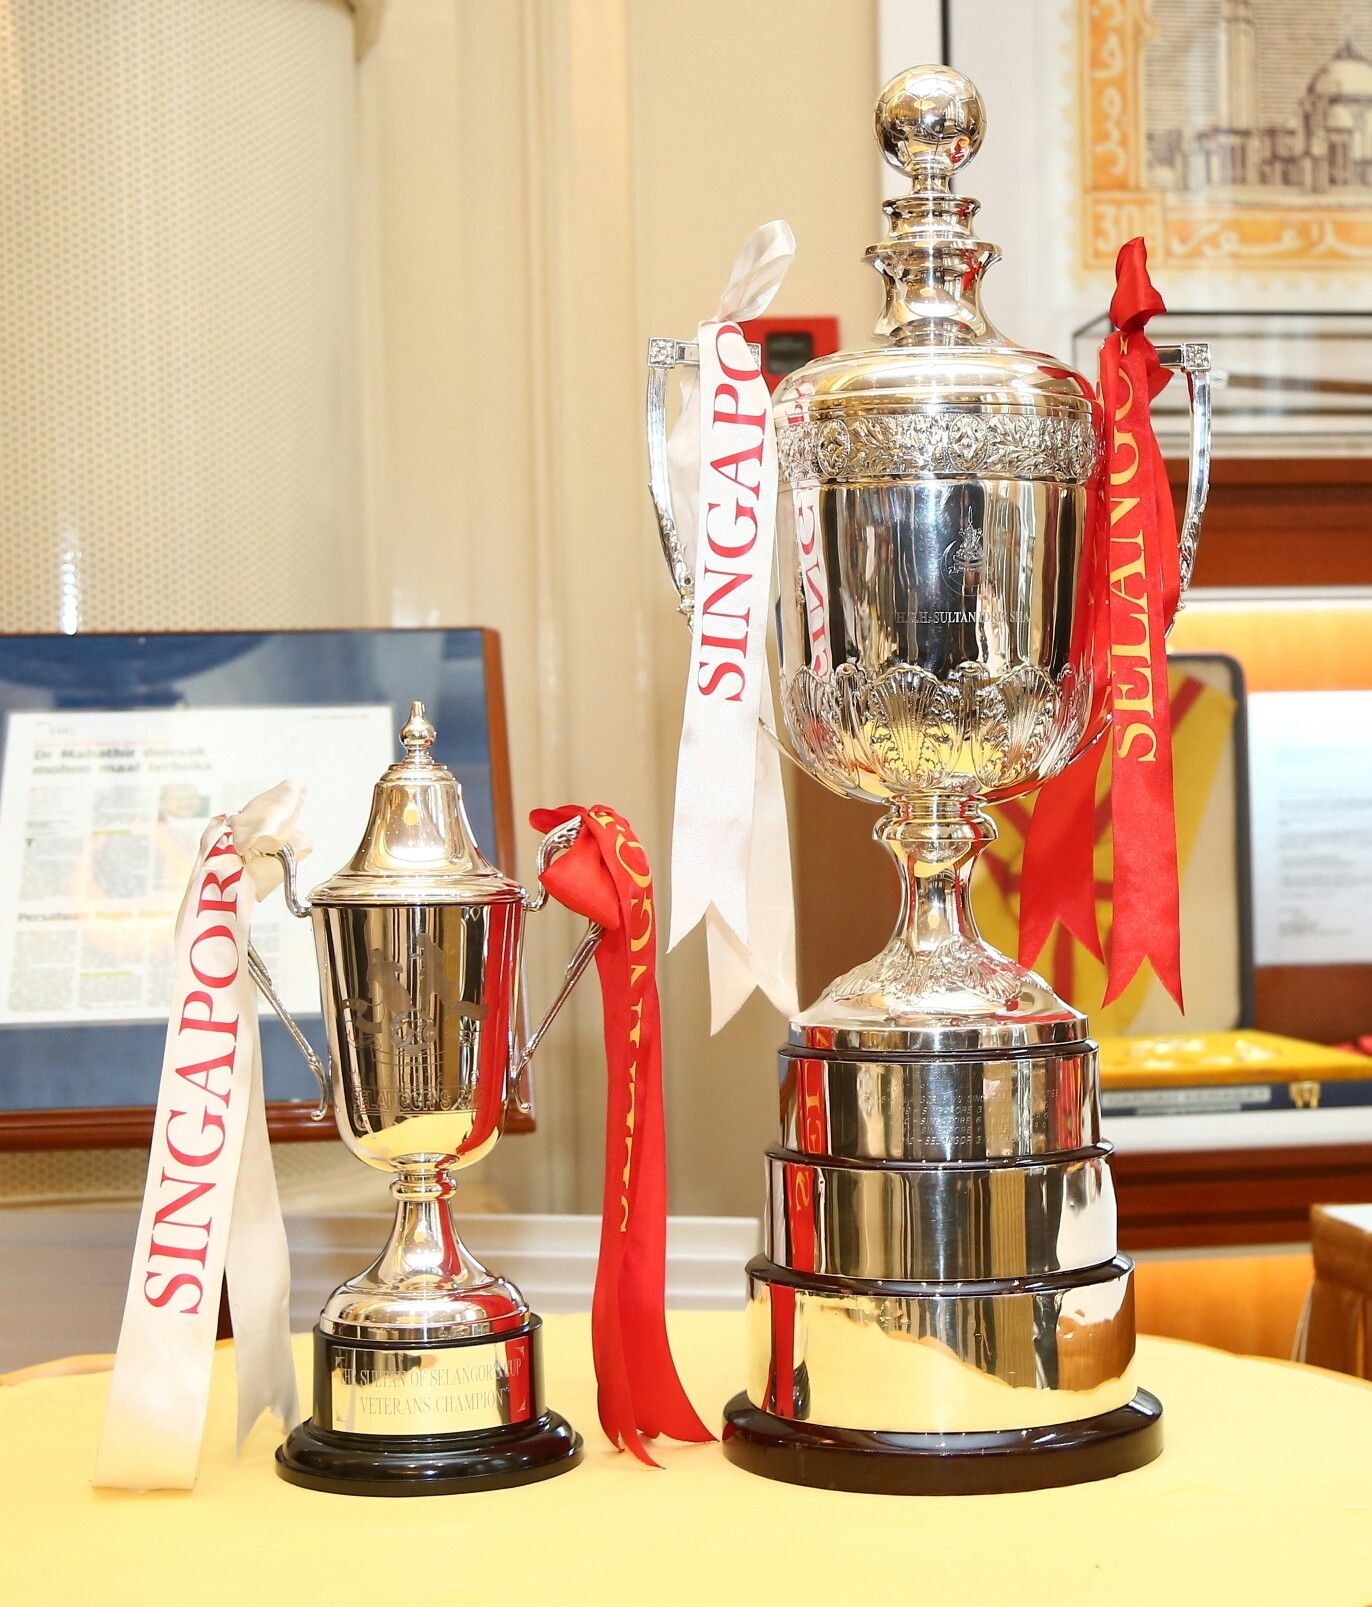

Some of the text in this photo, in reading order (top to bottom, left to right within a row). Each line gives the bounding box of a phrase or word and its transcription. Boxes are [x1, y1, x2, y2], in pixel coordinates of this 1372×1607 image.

[1109, 335, 1157, 763] SELANGO
[933, 611, 976, 624] SULTAN
[144, 829, 245, 1315] SINGAPORE
[360, 1369, 407, 1388] SULTAN
[411, 1369, 427, 1387] OF
[360, 1396, 431, 1415] VETERANS
